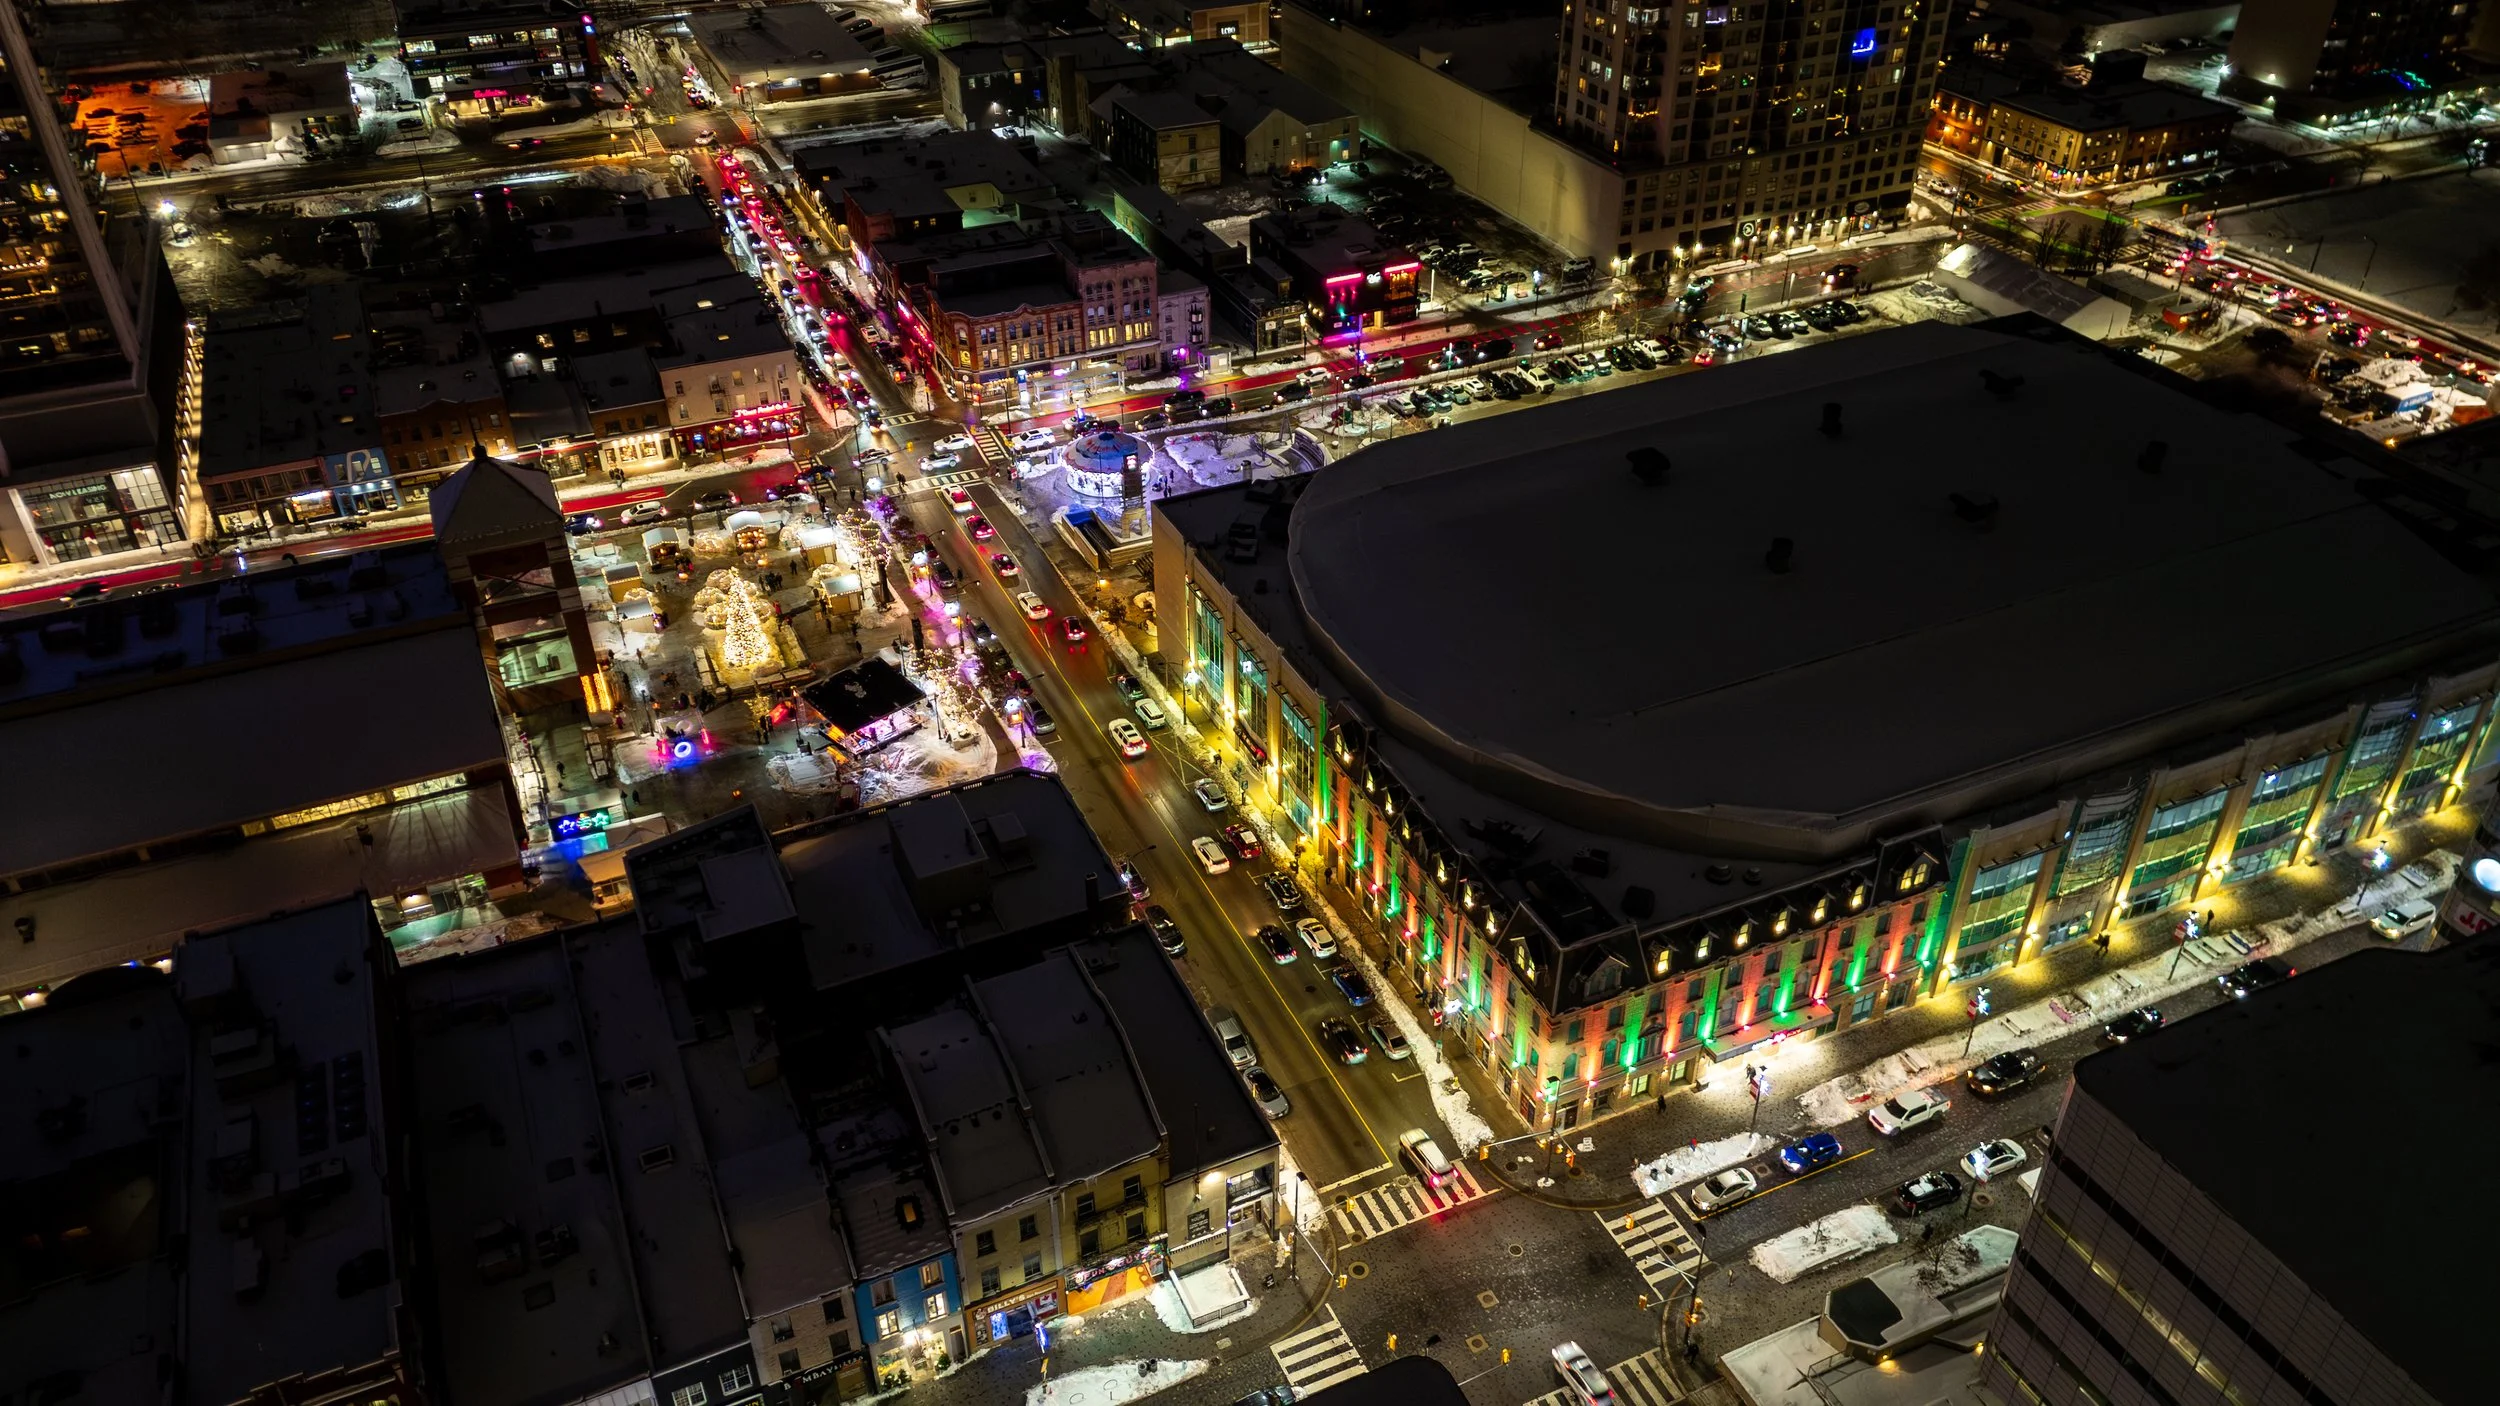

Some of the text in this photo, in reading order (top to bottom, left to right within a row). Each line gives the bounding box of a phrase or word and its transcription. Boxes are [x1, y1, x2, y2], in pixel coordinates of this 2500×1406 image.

[1221, 27, 1235, 35] LCBO
[48, 484, 107, 499] NOW LEASING
[986, 1293, 1026, 1314] BILLY'S
